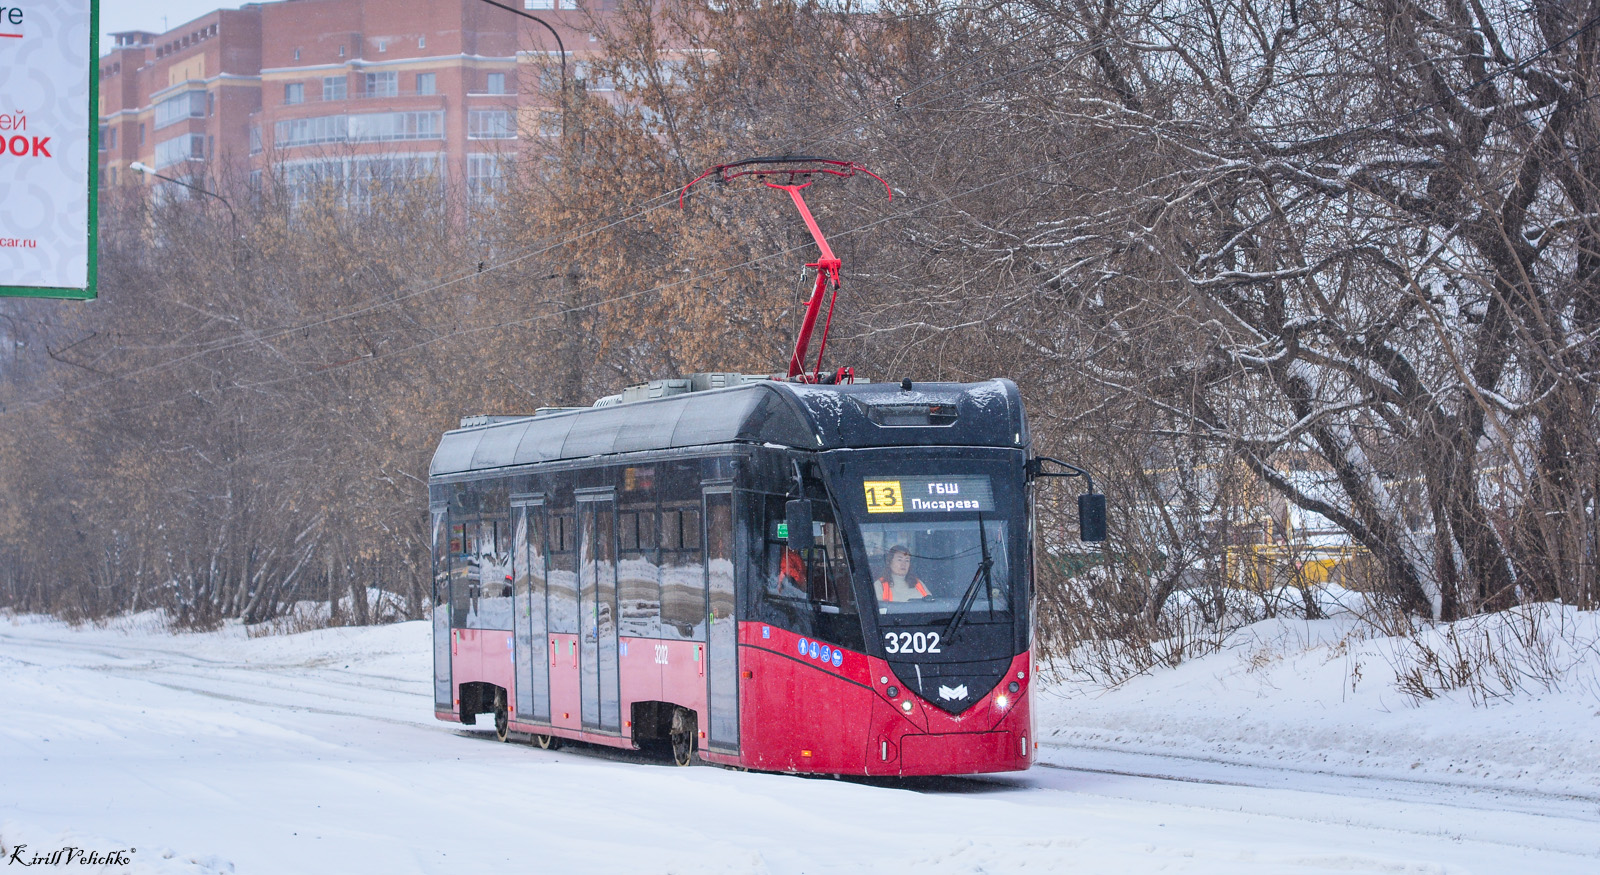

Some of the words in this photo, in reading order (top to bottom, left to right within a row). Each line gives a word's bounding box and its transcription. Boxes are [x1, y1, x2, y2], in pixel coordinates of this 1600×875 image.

[866, 487, 898, 507] 13
[927, 483, 959, 494] ГБШ
[911, 499, 980, 512] Писарева
[884, 631, 941, 654] 3202
[654, 644, 669, 665] 3202
